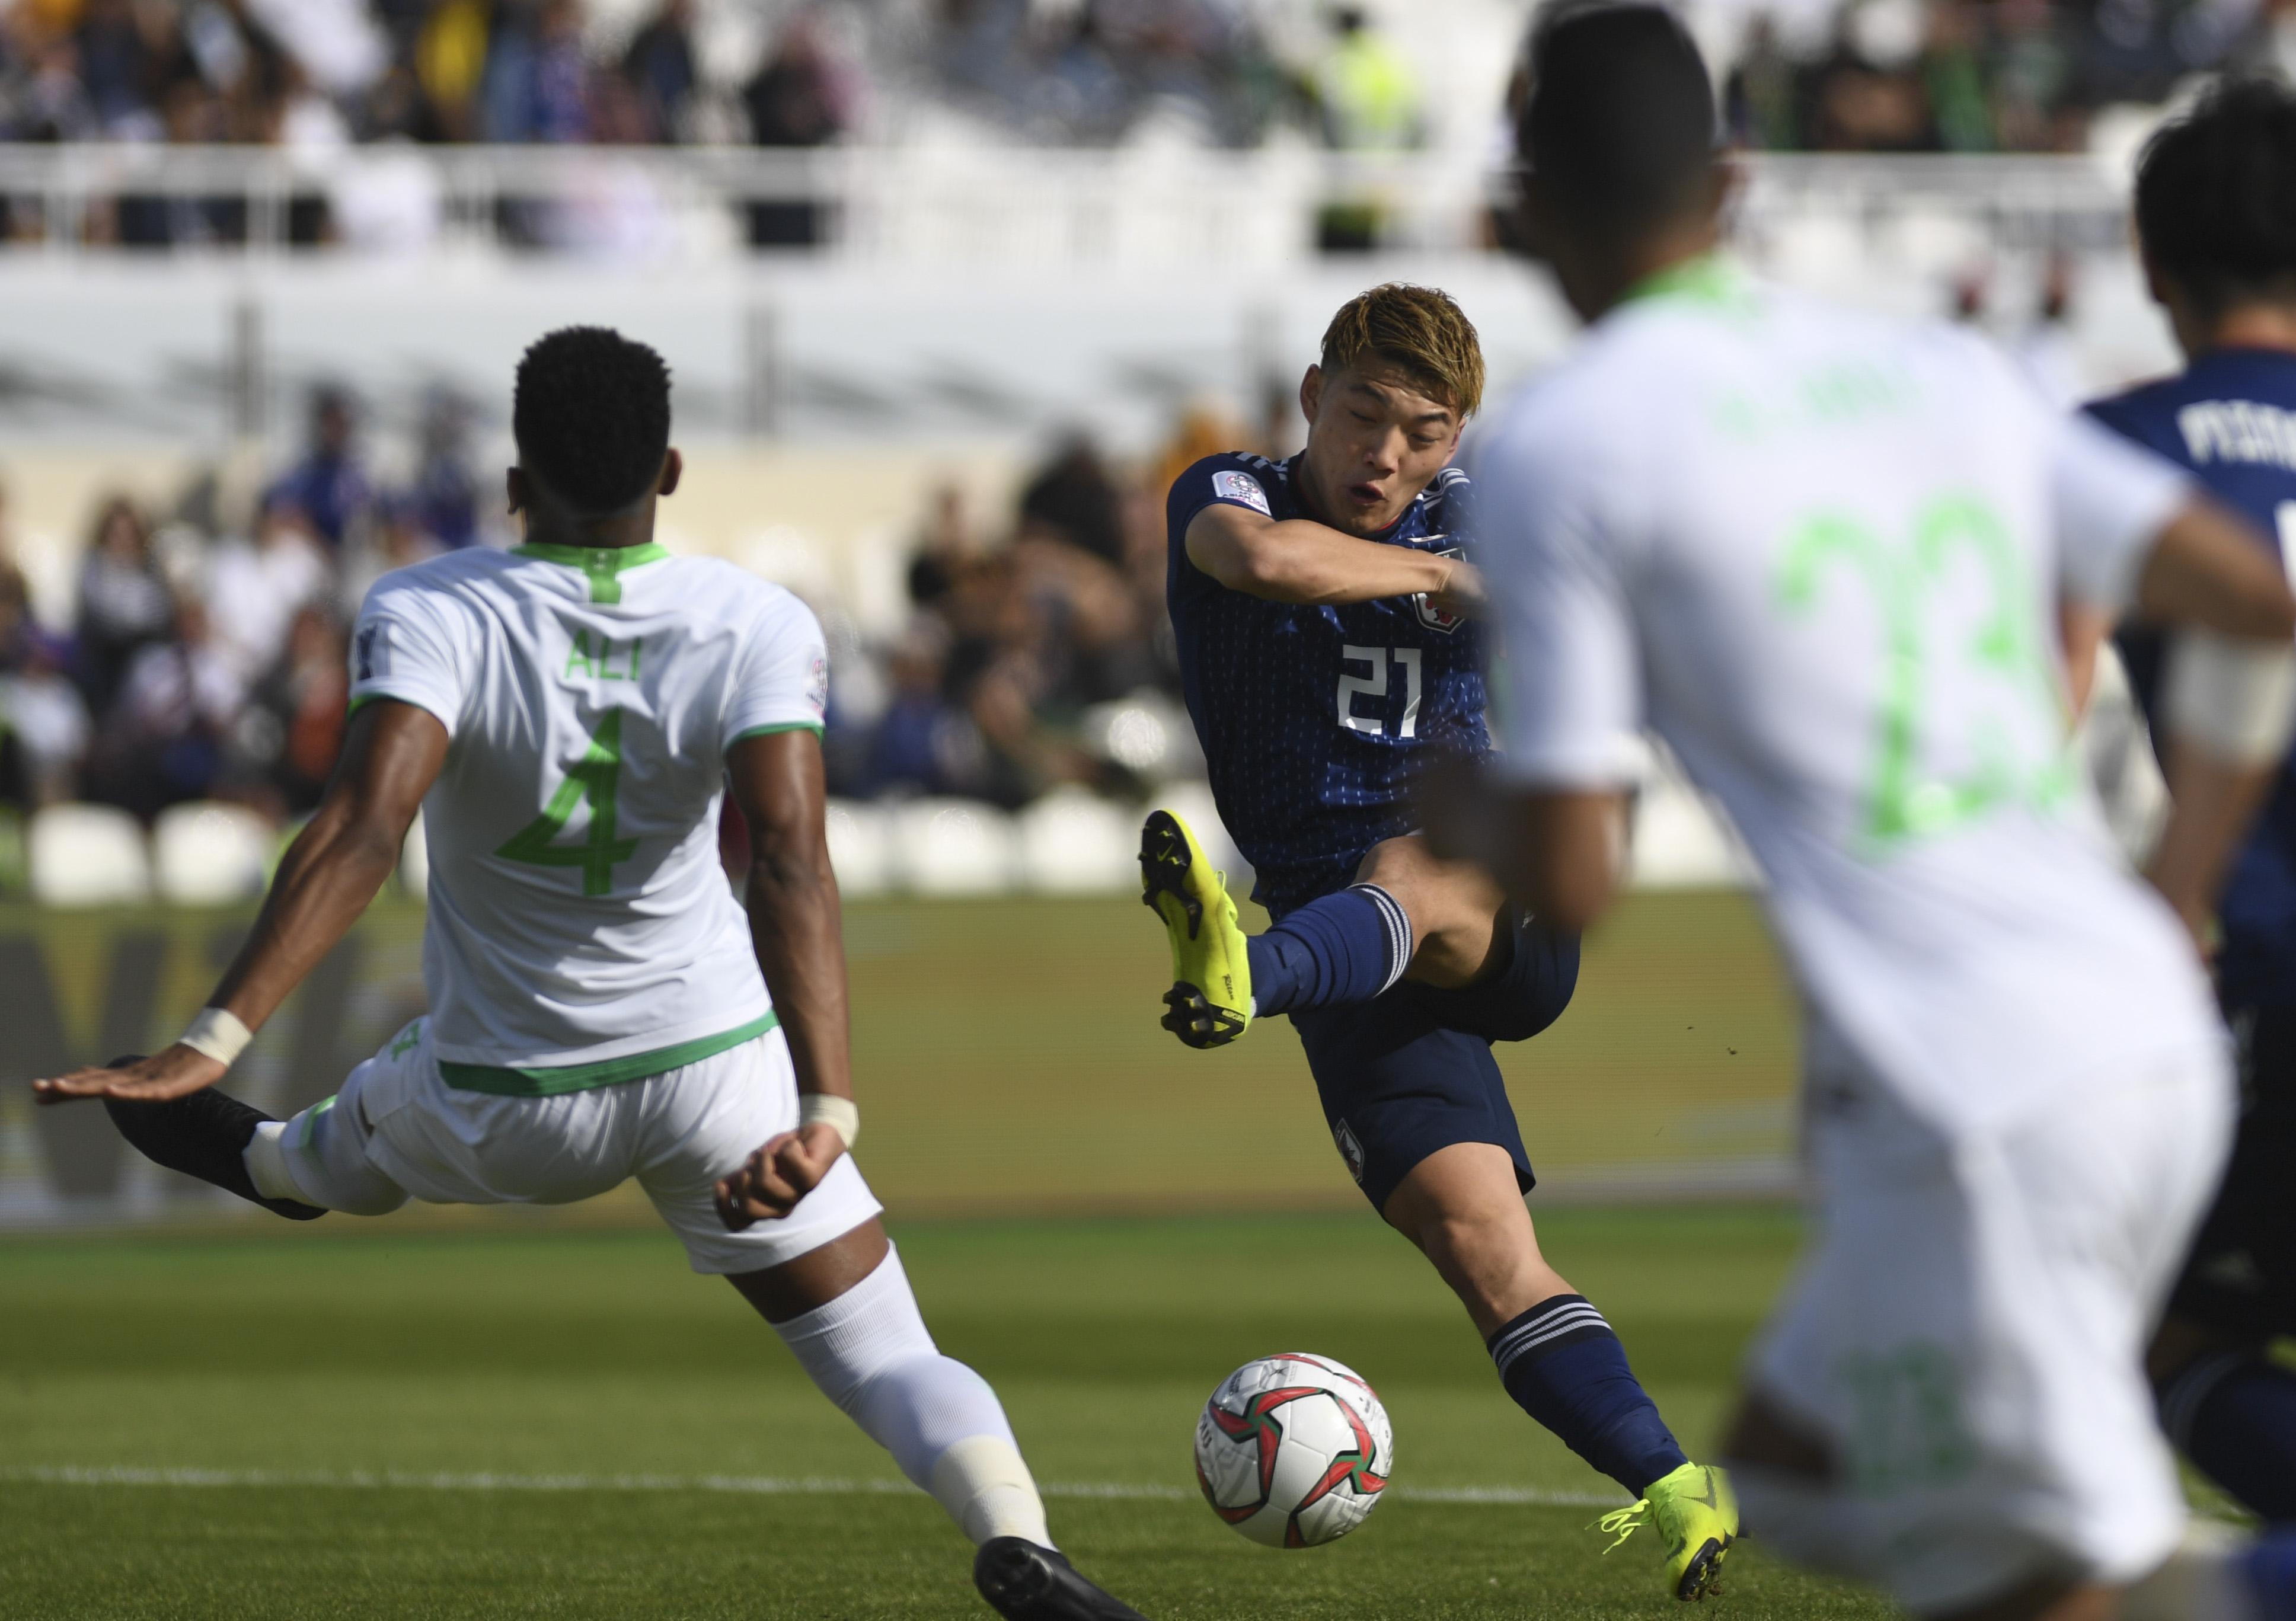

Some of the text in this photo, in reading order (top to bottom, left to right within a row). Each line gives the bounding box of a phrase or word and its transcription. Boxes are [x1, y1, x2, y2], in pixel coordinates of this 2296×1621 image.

[565, 627, 643, 681] ALI
[1337, 644, 1422, 737] 21
[493, 704, 639, 897] 4
